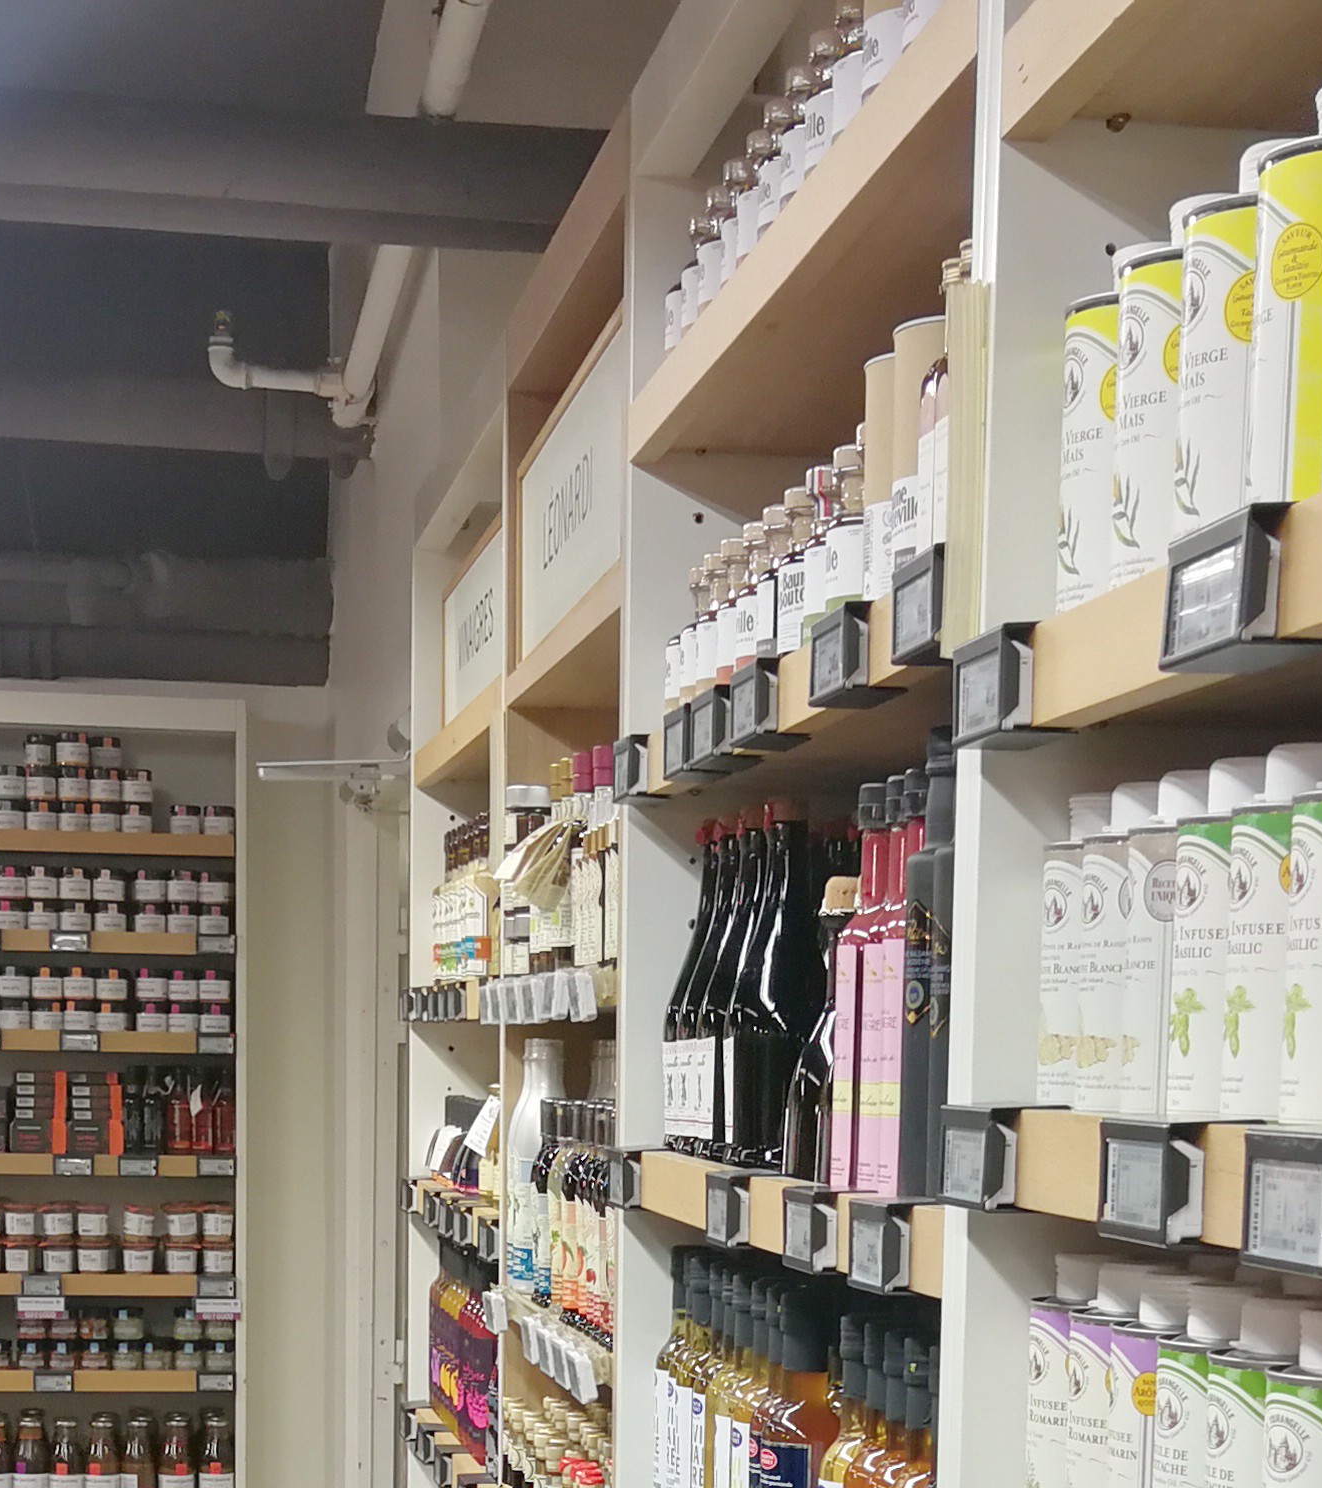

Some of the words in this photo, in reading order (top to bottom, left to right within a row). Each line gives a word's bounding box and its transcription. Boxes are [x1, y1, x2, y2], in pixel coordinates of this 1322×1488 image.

[1185, 347, 1228, 370] VIERGE
[1124, 390, 1168, 411] VIERGE
[1180, 927, 1224, 941] INFUSE
[1231, 921, 1285, 936] INFUSEE
